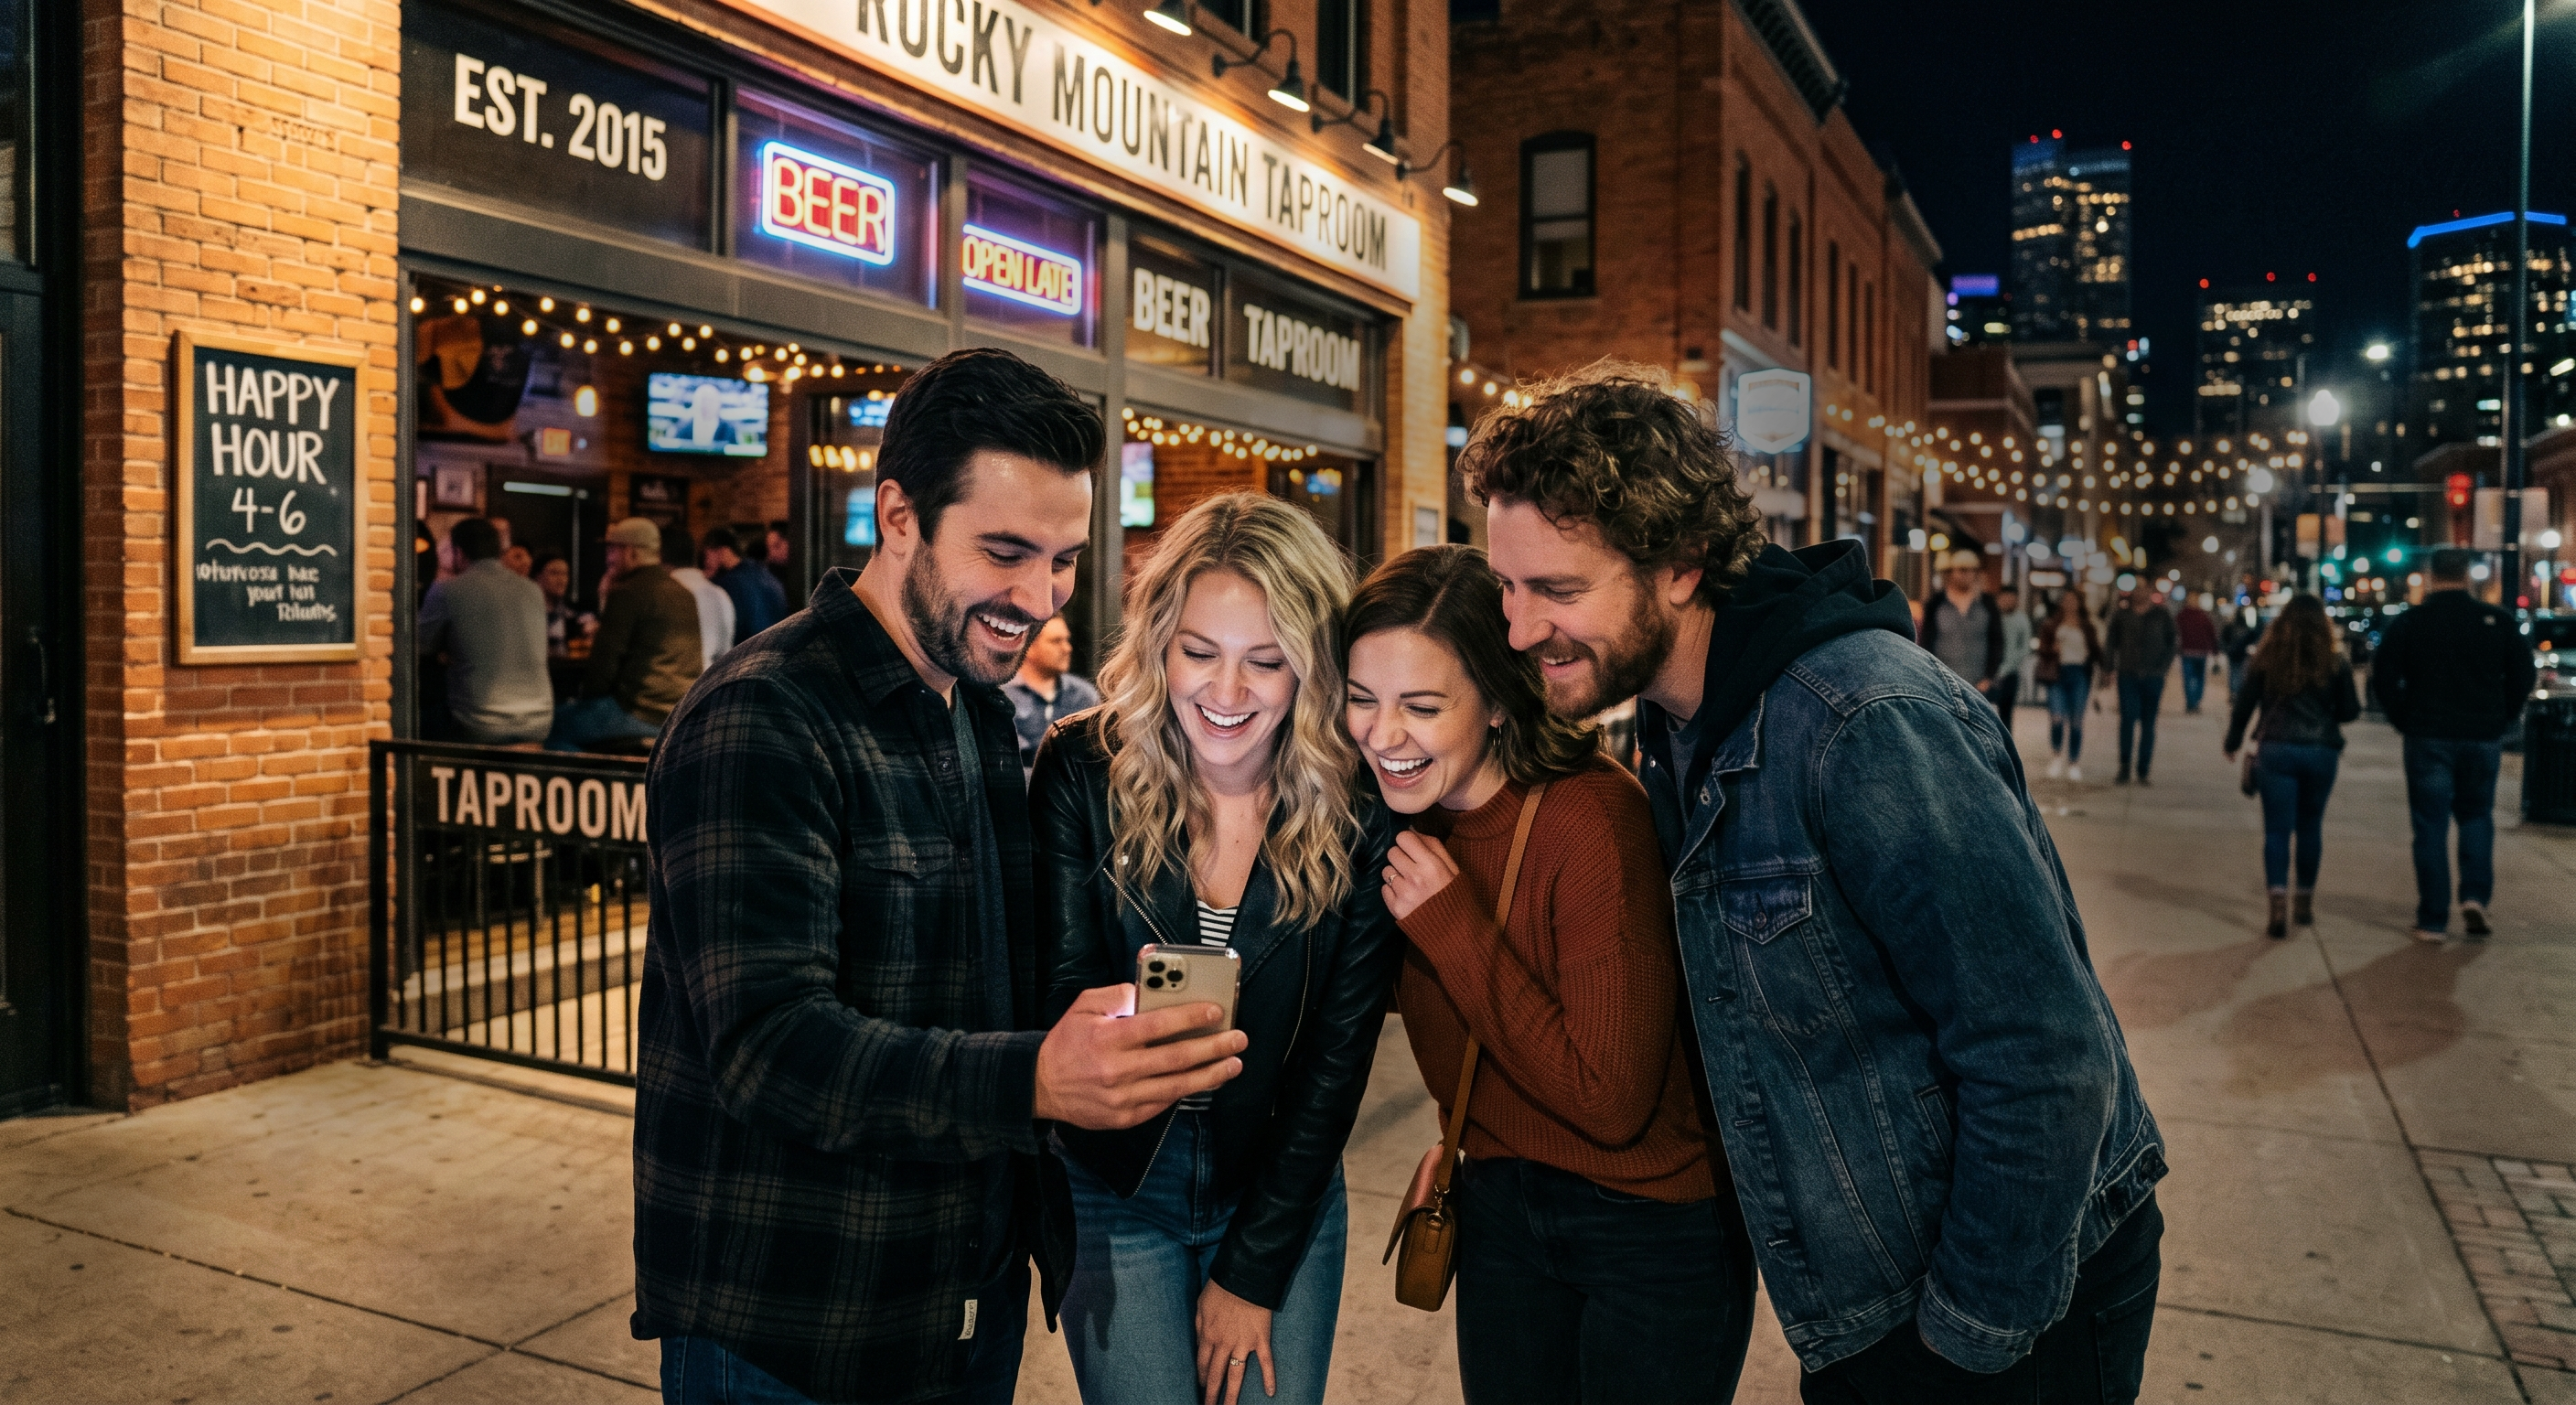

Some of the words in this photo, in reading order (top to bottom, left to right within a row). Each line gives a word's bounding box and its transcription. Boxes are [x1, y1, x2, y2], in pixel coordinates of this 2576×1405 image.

[455, 52, 554, 149] EST.
[567, 92, 668, 181] 2015
[1052, 41, 1249, 207] MOUNTAIN
[1262, 151, 1387, 272] TAPROOM
[771, 156, 886, 253] BEER
[961, 235, 1025, 291] OPEN
[1025, 255, 1074, 306] LATE
[1132, 266, 1211, 349] BEER
[1242, 303, 1361, 392] TAPROOM
[206, 360, 340, 431] HAPPY
[210, 422, 327, 486] HOUR
[231, 487, 307, 535] 4-6
[430, 766, 648, 843] TAPROOM
